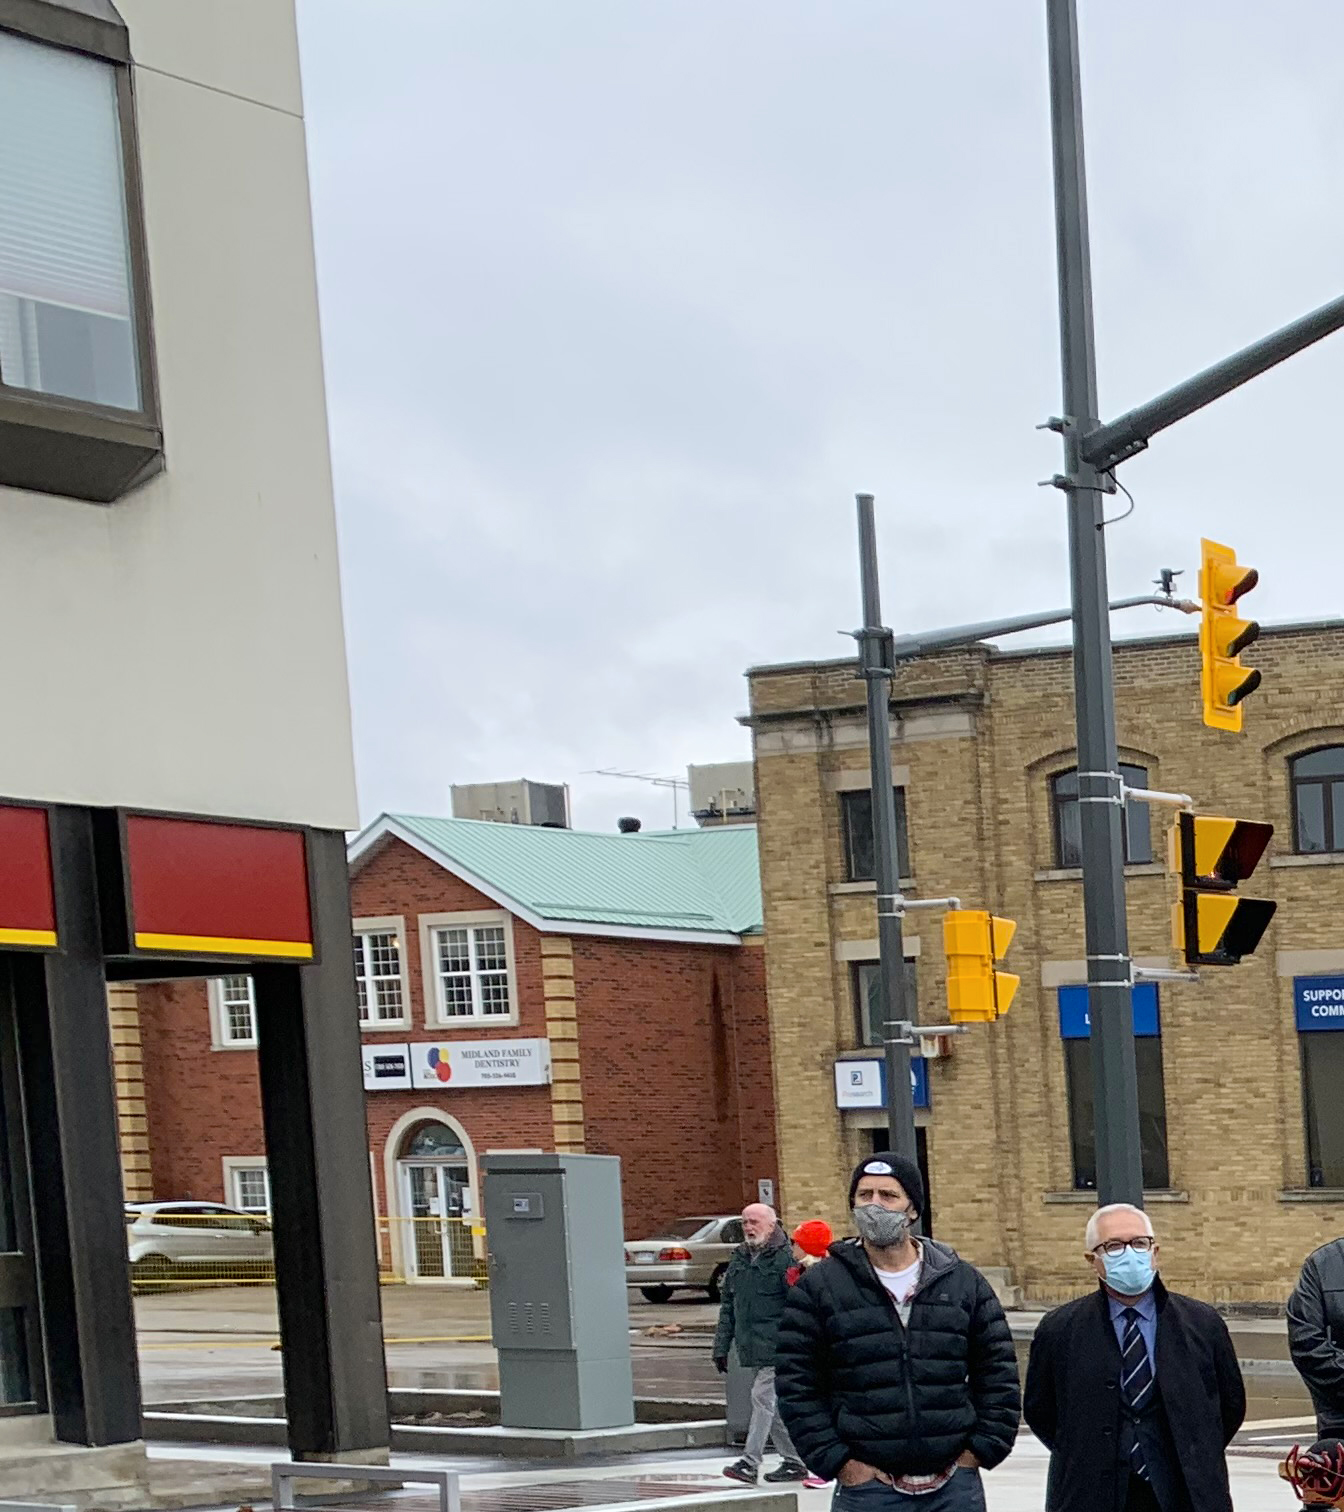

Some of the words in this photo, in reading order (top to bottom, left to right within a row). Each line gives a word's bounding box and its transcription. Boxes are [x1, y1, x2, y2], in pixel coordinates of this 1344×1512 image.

[461, 1049, 501, 1060] MIDLAND
[501, 1048, 532, 1058] FAMILY
[474, 1059, 520, 1068] DENTISTRY
